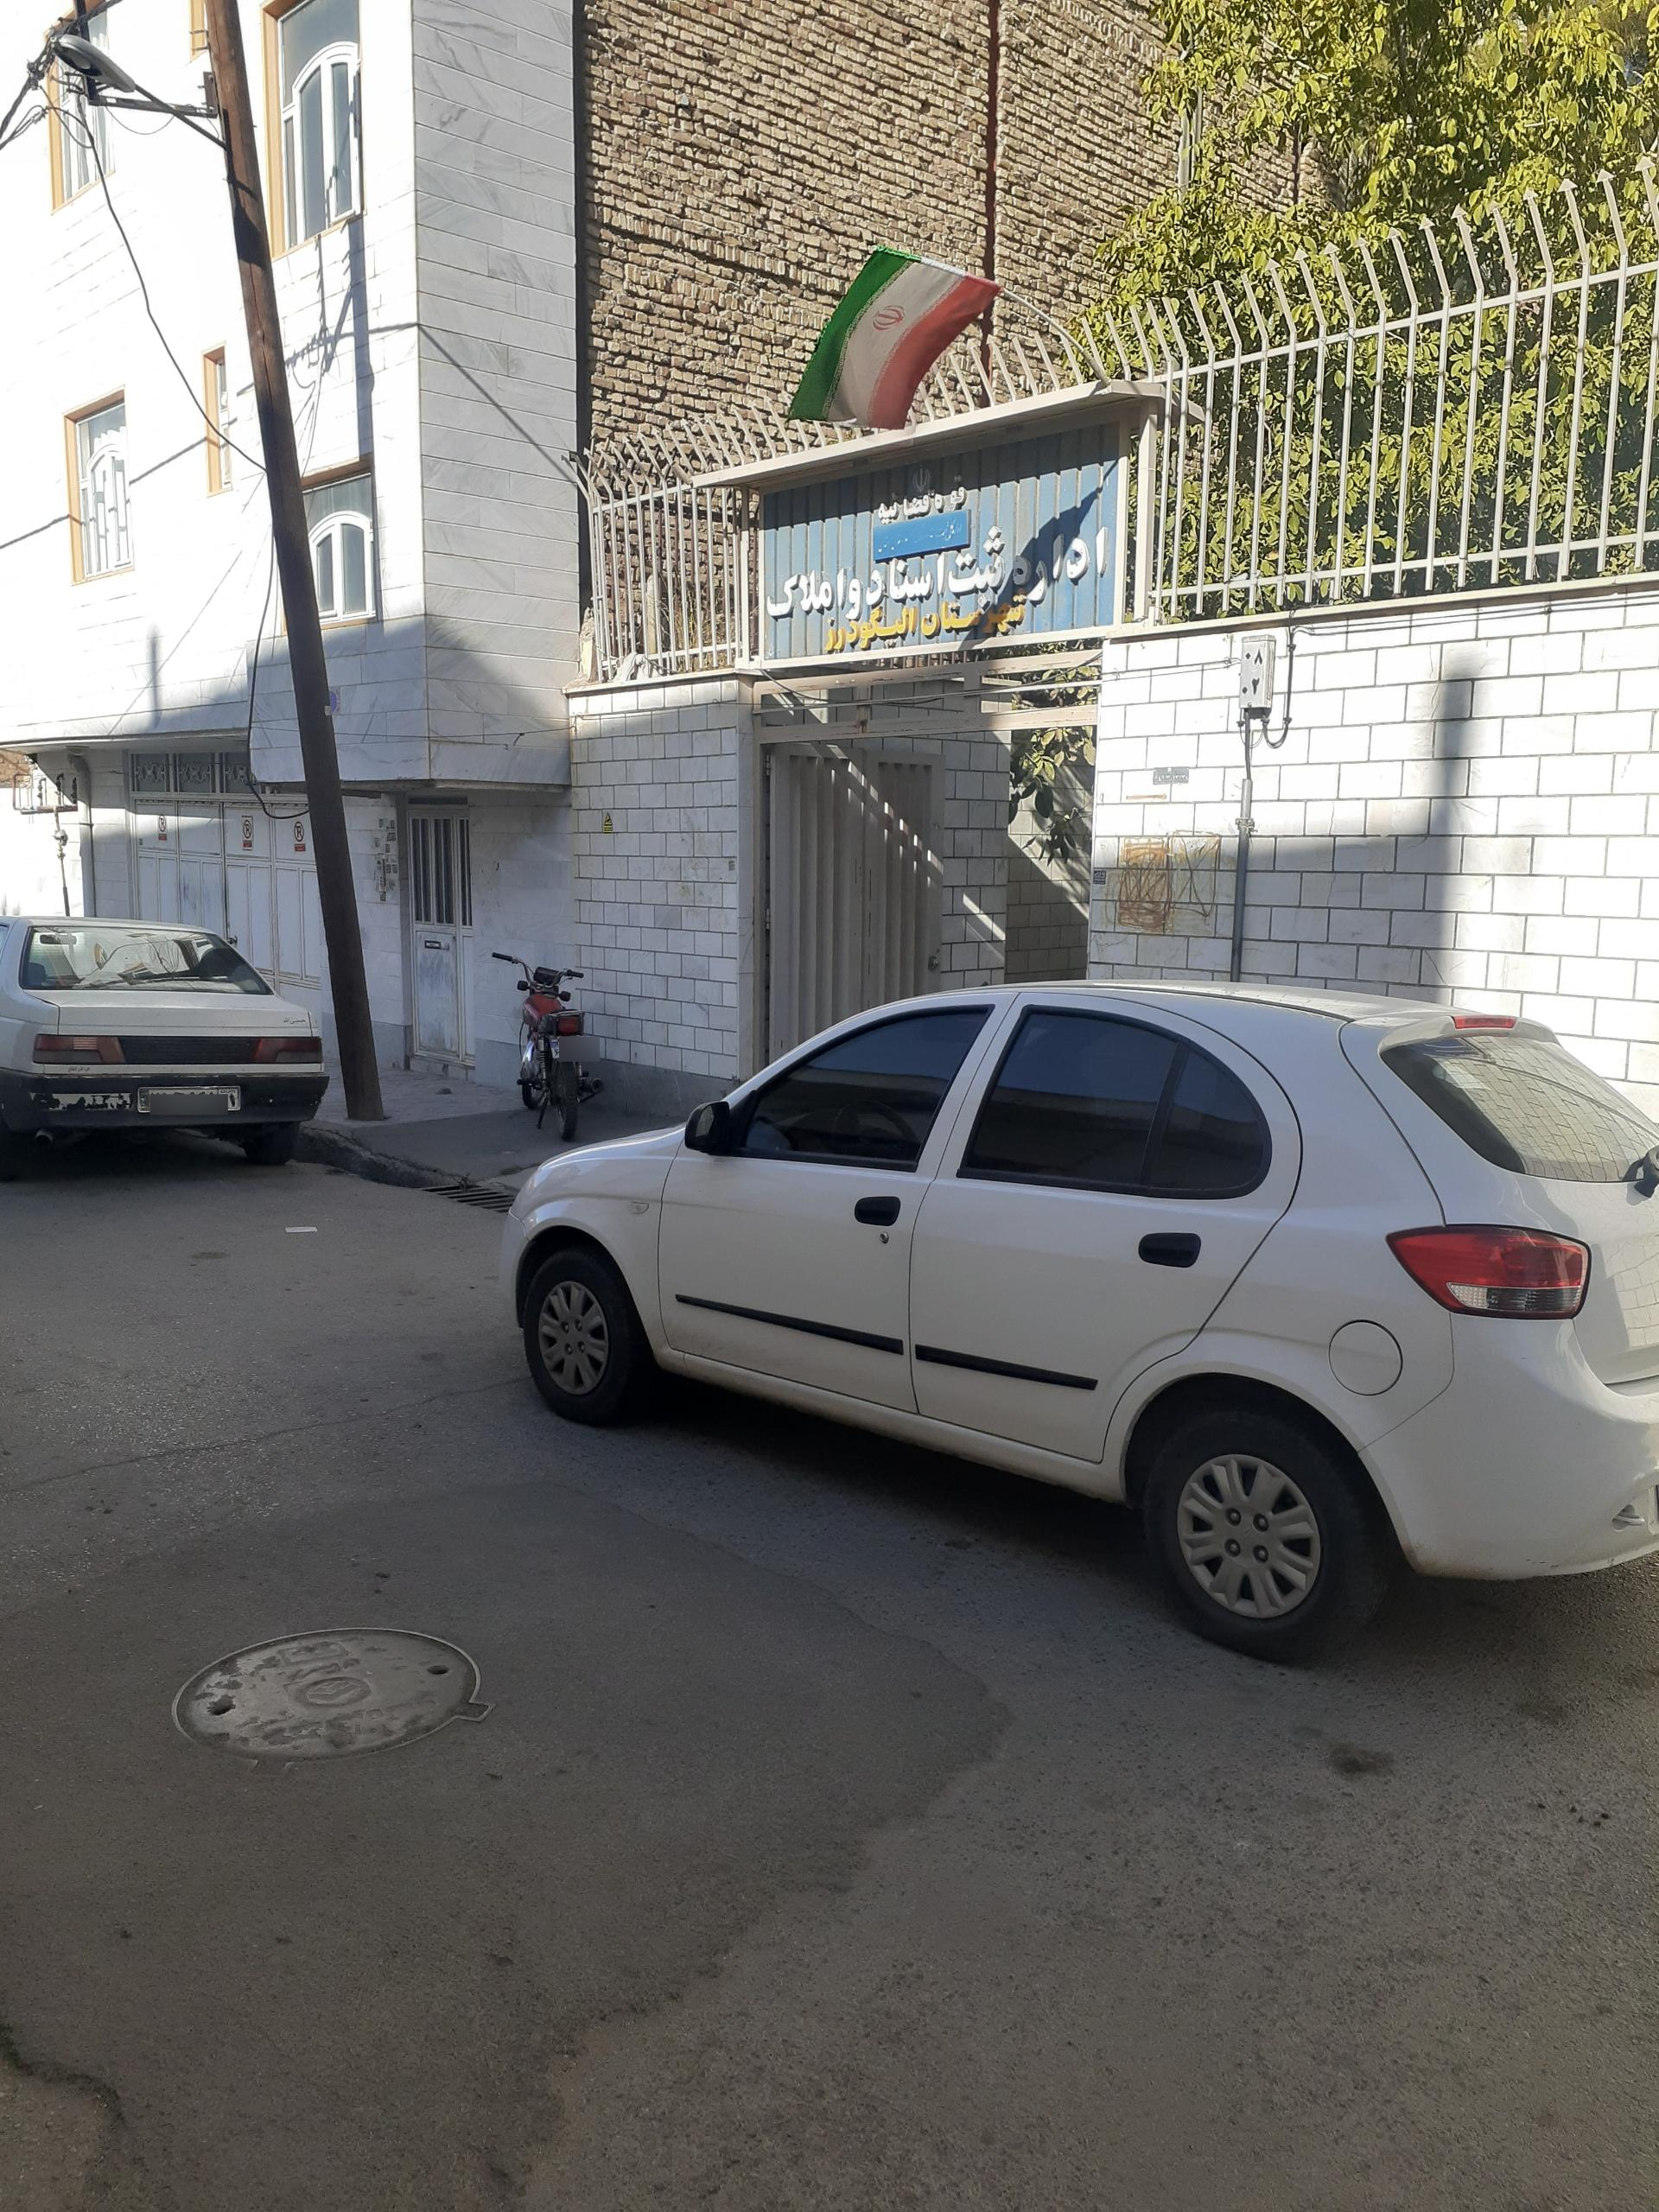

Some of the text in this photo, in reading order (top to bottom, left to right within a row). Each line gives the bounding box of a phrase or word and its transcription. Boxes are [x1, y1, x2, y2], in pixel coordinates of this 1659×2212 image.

[935, 474, 966, 511] قوه
[866, 552, 946, 607] اسناد
[949, 526, 1005, 611] ثبت
[1014, 526, 1109, 602] اداره
[766, 568, 847, 616] املاک
[846, 579, 861, 620] و
[825, 591, 1026, 651] شهرستان الیگودرز
